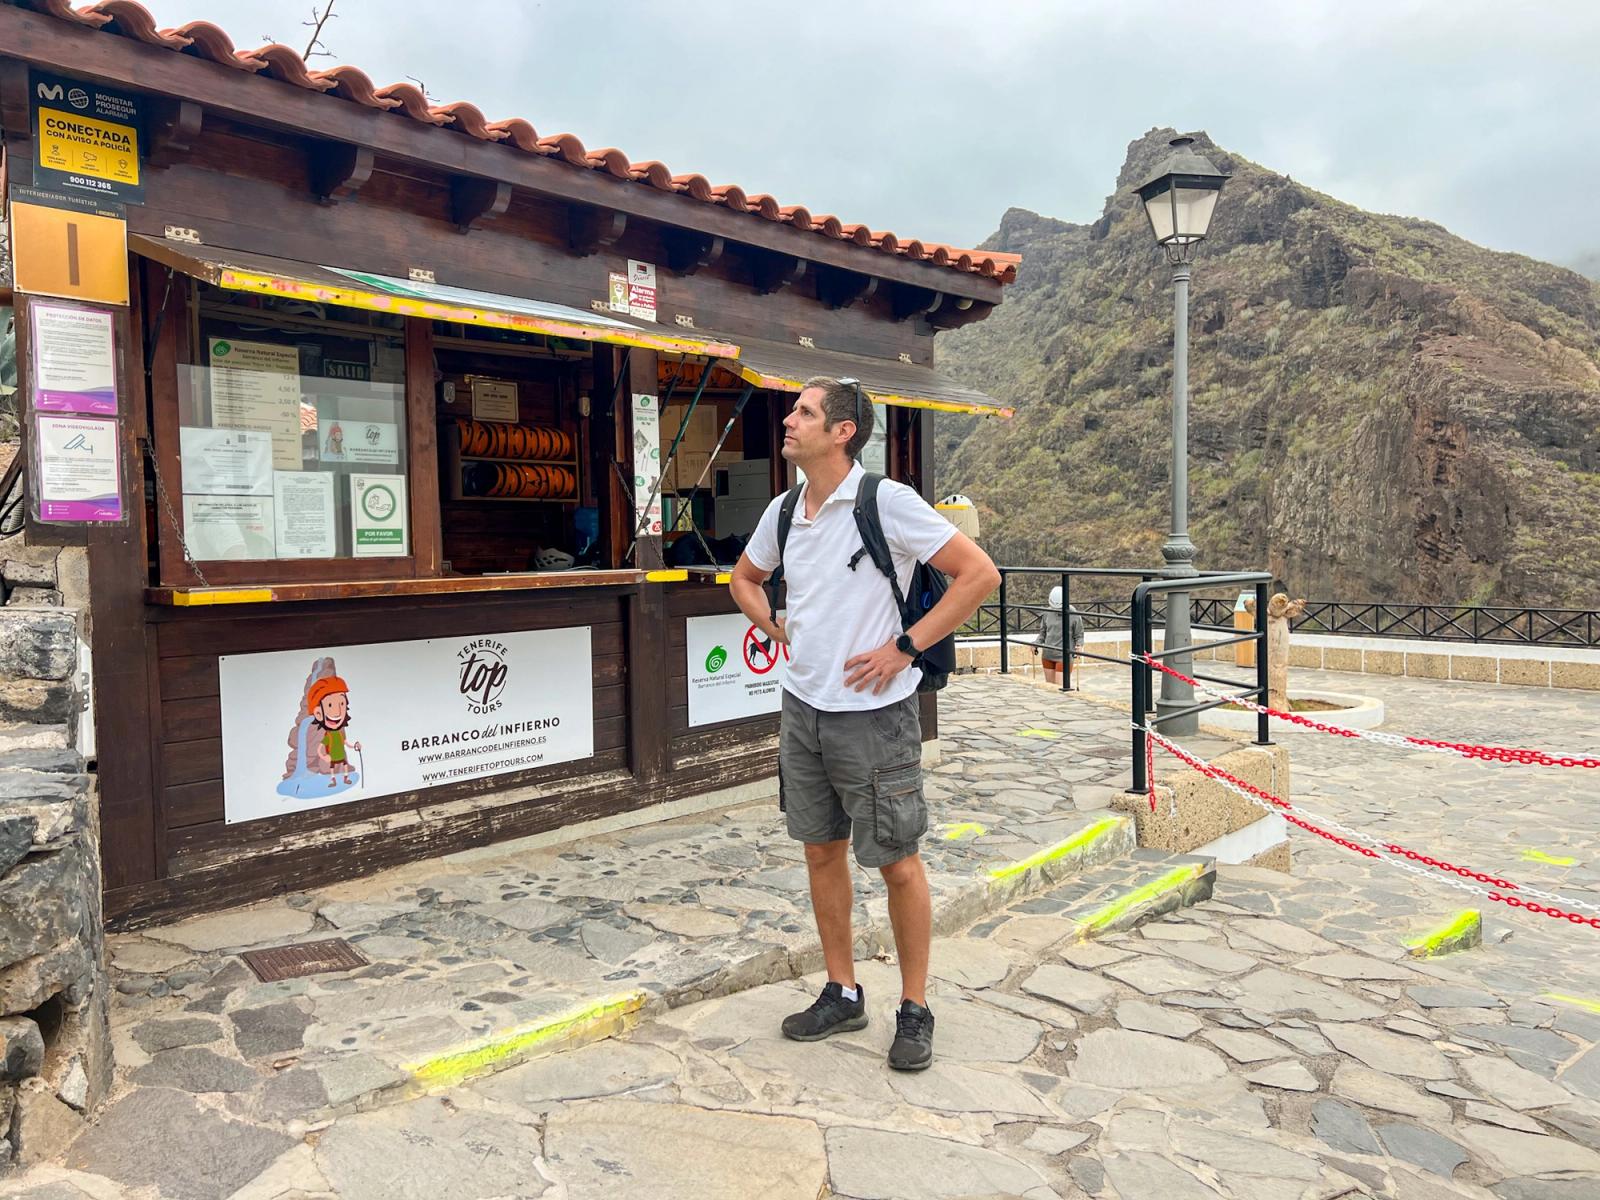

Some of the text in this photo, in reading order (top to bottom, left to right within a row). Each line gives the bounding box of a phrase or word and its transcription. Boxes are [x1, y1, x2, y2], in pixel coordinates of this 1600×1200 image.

[95, 93, 133, 107] MOVISTAR
[95, 100, 137, 115] PROSEGUR
[95, 108, 129, 120] ALARMAS
[46, 118, 131, 145] CONECTADA
[46, 130, 65, 138] CON
[66, 133, 92, 145] AVISO
[100, 142, 131, 153] POLICÍA
[69, 176, 84, 184] 900
[86, 178, 96, 186] 112
[97, 180, 112, 190] 365
[631, 285, 655, 296] Alarma
[257, 348, 276, 356] Natural
[276, 350, 297, 358] Especial
[329, 364, 368, 378] SALID
[457, 639, 508, 660] TENERIFE
[460, 652, 508, 705] top
[692, 672, 741, 684] Reserva Natural Especial
[467, 700, 503, 715] TOURS
[401, 717, 561, 751] BARRANCO del INFIERNO
[418, 735, 547, 764] WWW.BARRANCODELINFIERNO.ES
[422, 753, 544, 781] WWW.TENERIFETOPTOURS.COM
